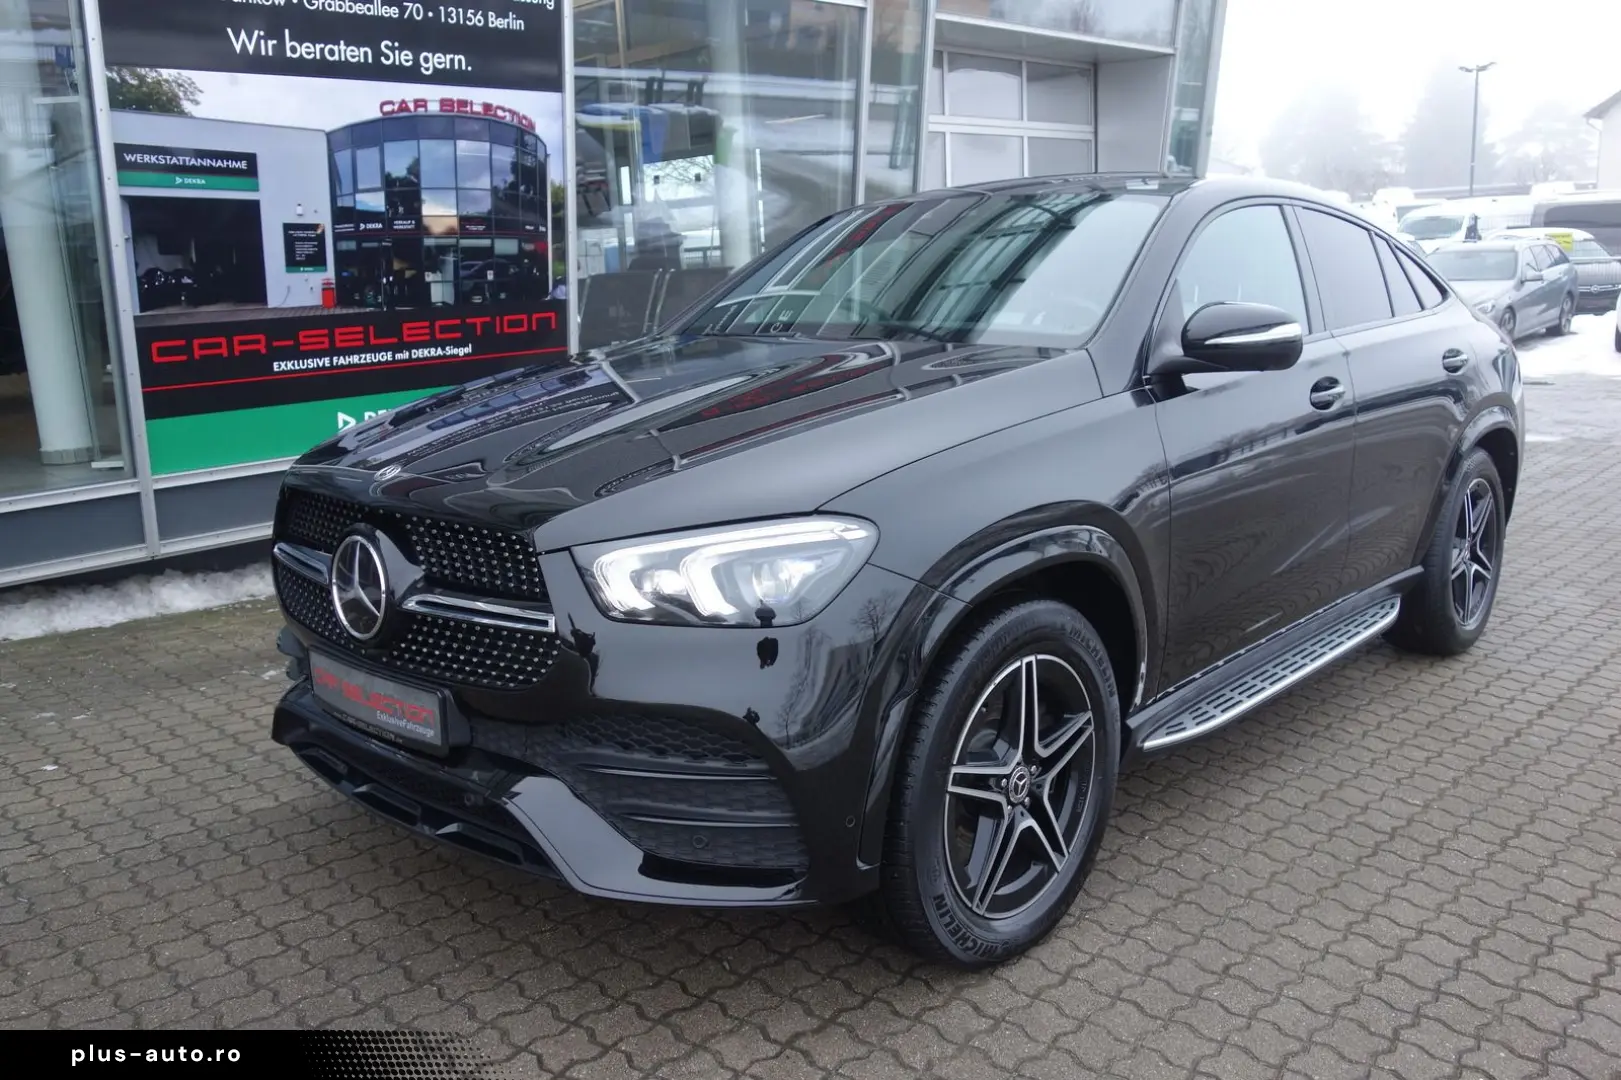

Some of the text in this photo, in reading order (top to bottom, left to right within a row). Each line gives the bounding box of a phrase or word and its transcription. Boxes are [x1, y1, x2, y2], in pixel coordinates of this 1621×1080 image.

[403, 2, 424, 21] 70
[439, 6, 484, 27] 13156
[488, 11, 525, 31] Berlin
[226, 27, 473, 76] Wir beraten Sie gern.
[379, 98, 429, 117] CAR
[123, 152, 248, 170] WERKSTATTANNAHME
[150, 311, 556, 364] CAR-SELECTION
[273, 342, 472, 373] EXKLUSIVE FAHRZEUGE mit DEKRA-Siegel
